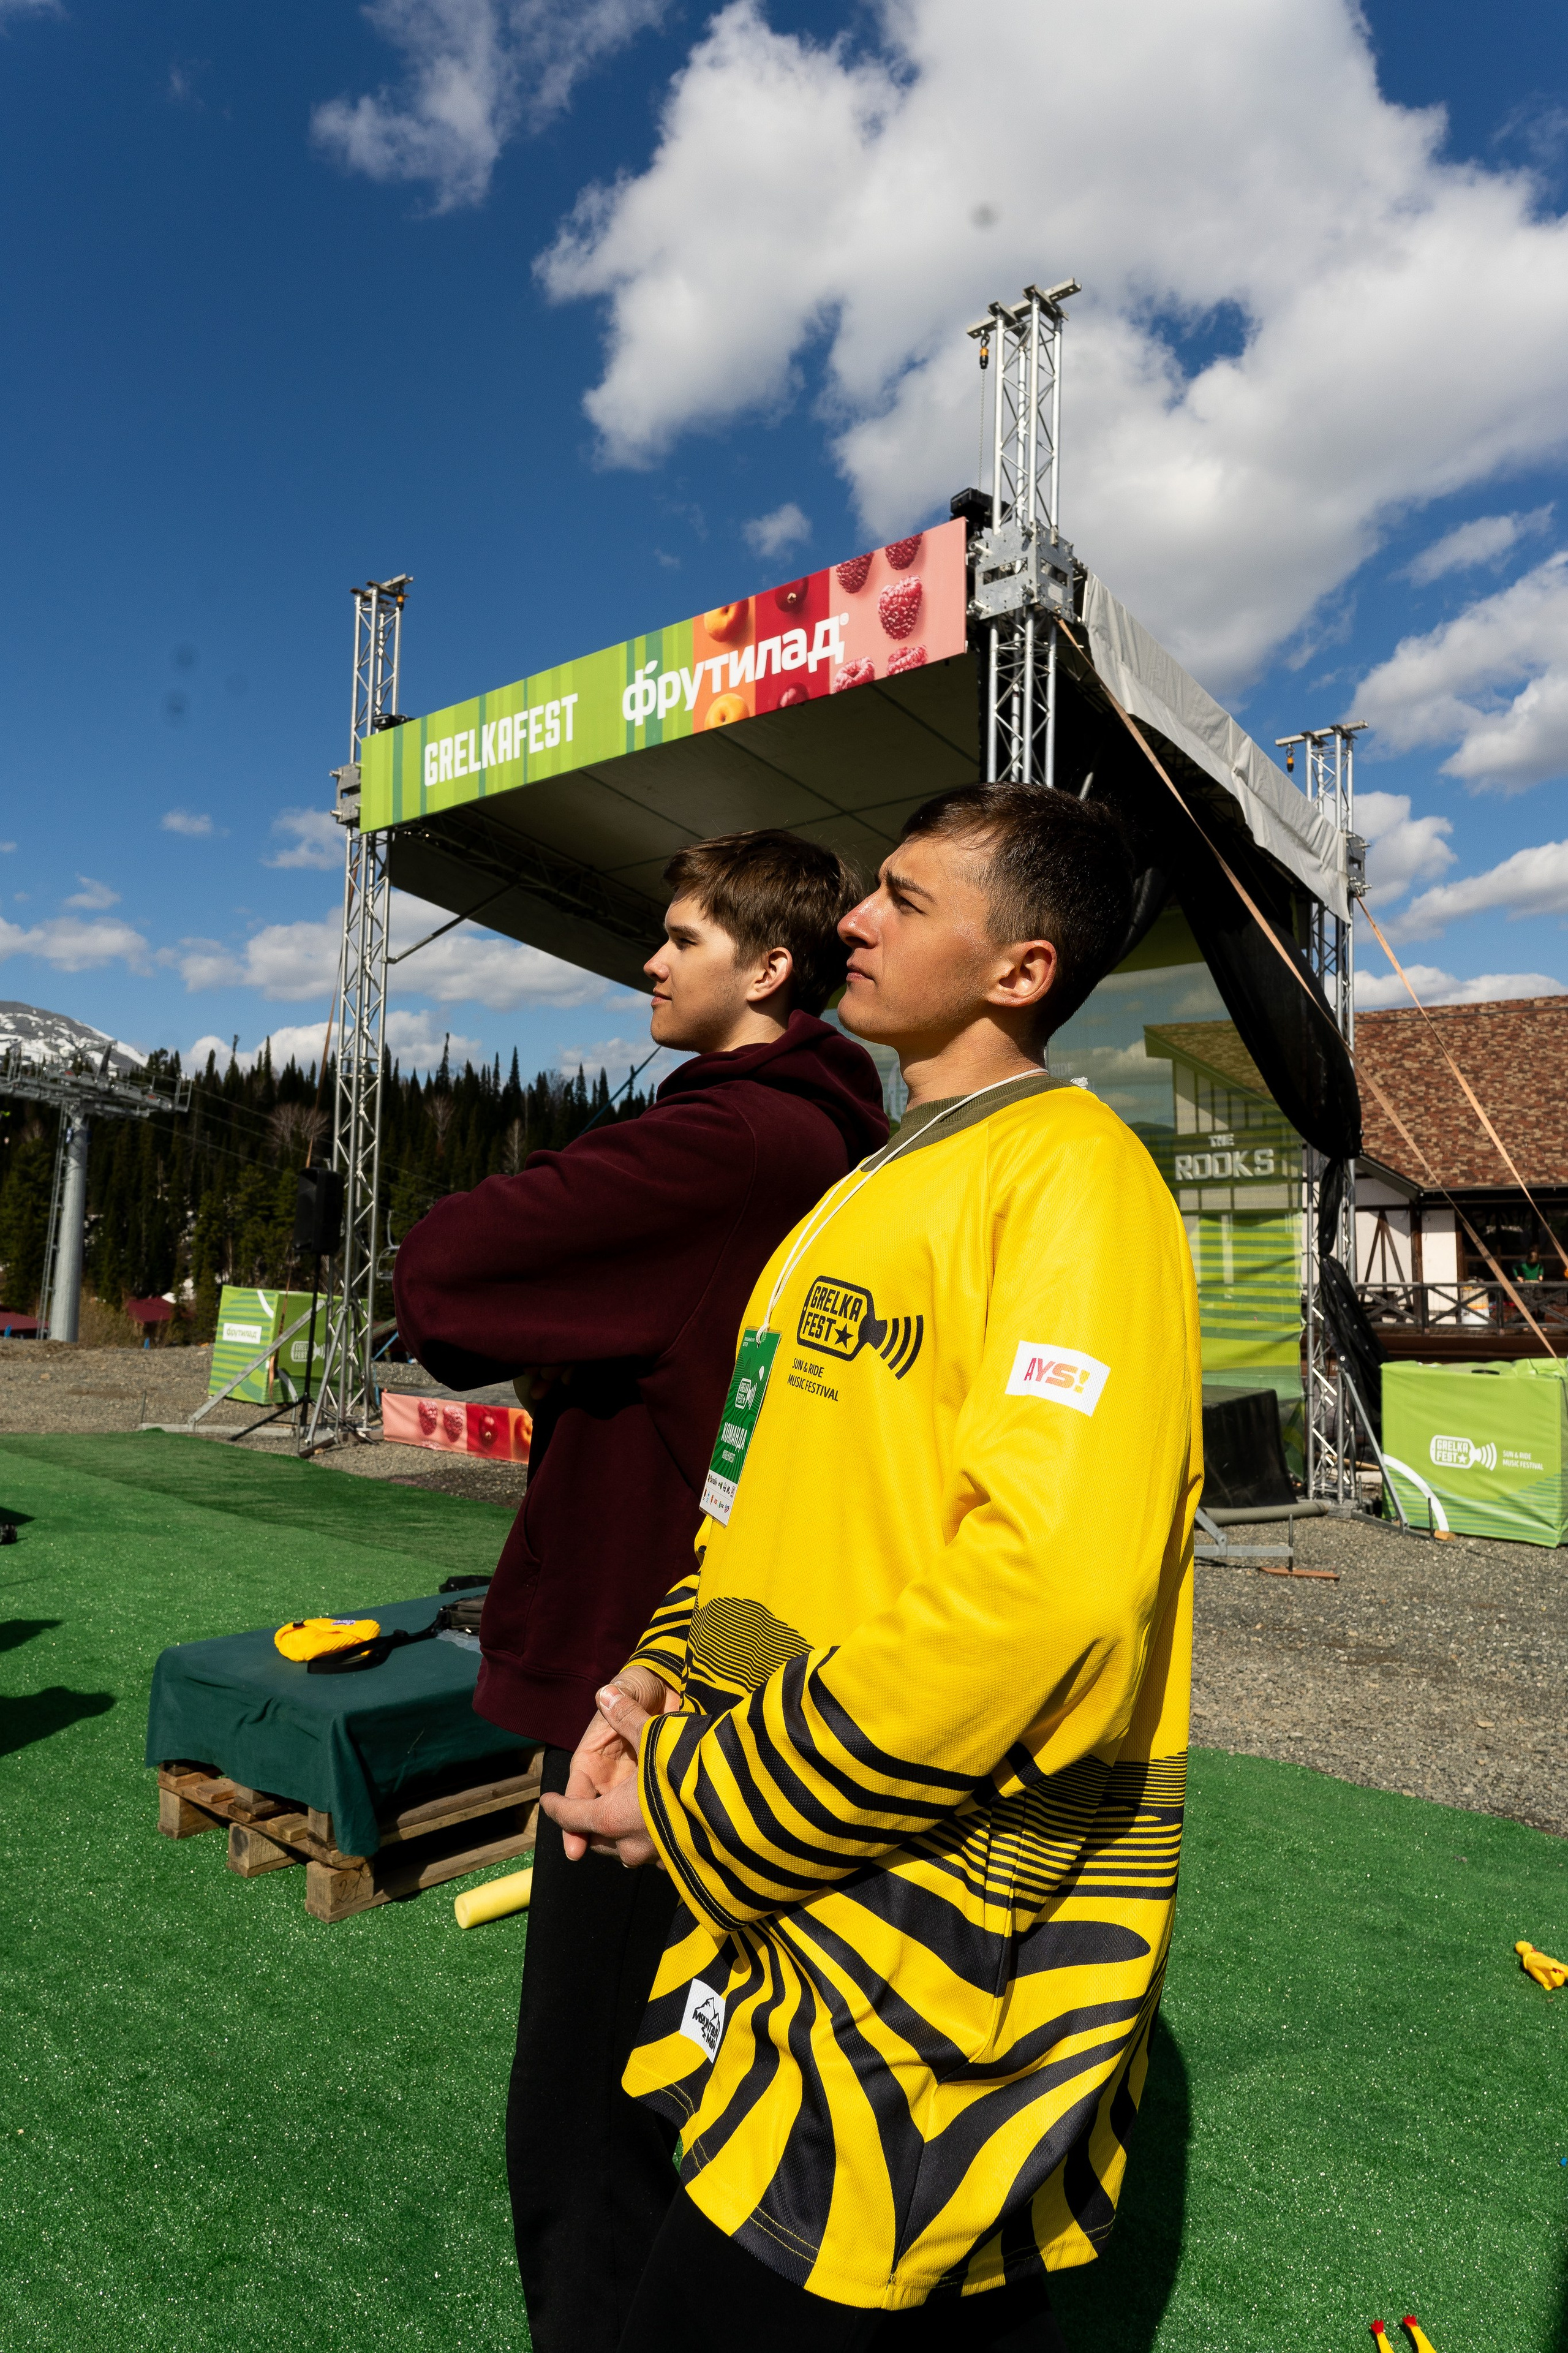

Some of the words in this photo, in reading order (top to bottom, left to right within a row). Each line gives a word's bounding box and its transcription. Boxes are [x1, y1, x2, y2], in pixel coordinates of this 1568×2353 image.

[424, 692, 578, 787] GRELKAFEST
[1208, 1133, 1235, 1148] THE
[1175, 1148, 1275, 1181] ROOKS
[810, 1285, 863, 1323] GRELKA
[802, 1312, 837, 1342] FEST
[792, 1358, 803, 1371] SUN
[803, 1362, 808, 1373] &
[808, 1363, 824, 1378] RIDE
[1023, 1358, 1090, 1394] AYS!
[787, 1374, 805, 1389] MUSIC
[805, 1380, 839, 1402] FESTIVAL
[720, 1421, 747, 1452] КОМАНДА
[1436, 1439, 1469, 1453] GRELKA
[1436, 1451, 1458, 1463] FEST
[1502, 1449, 1514, 1459] SUN
[1520, 1451, 1532, 1460] RIDE
[1502, 1459, 1519, 1468] MUSIC
[1520, 1460, 1544, 1471] FESTIVAL
